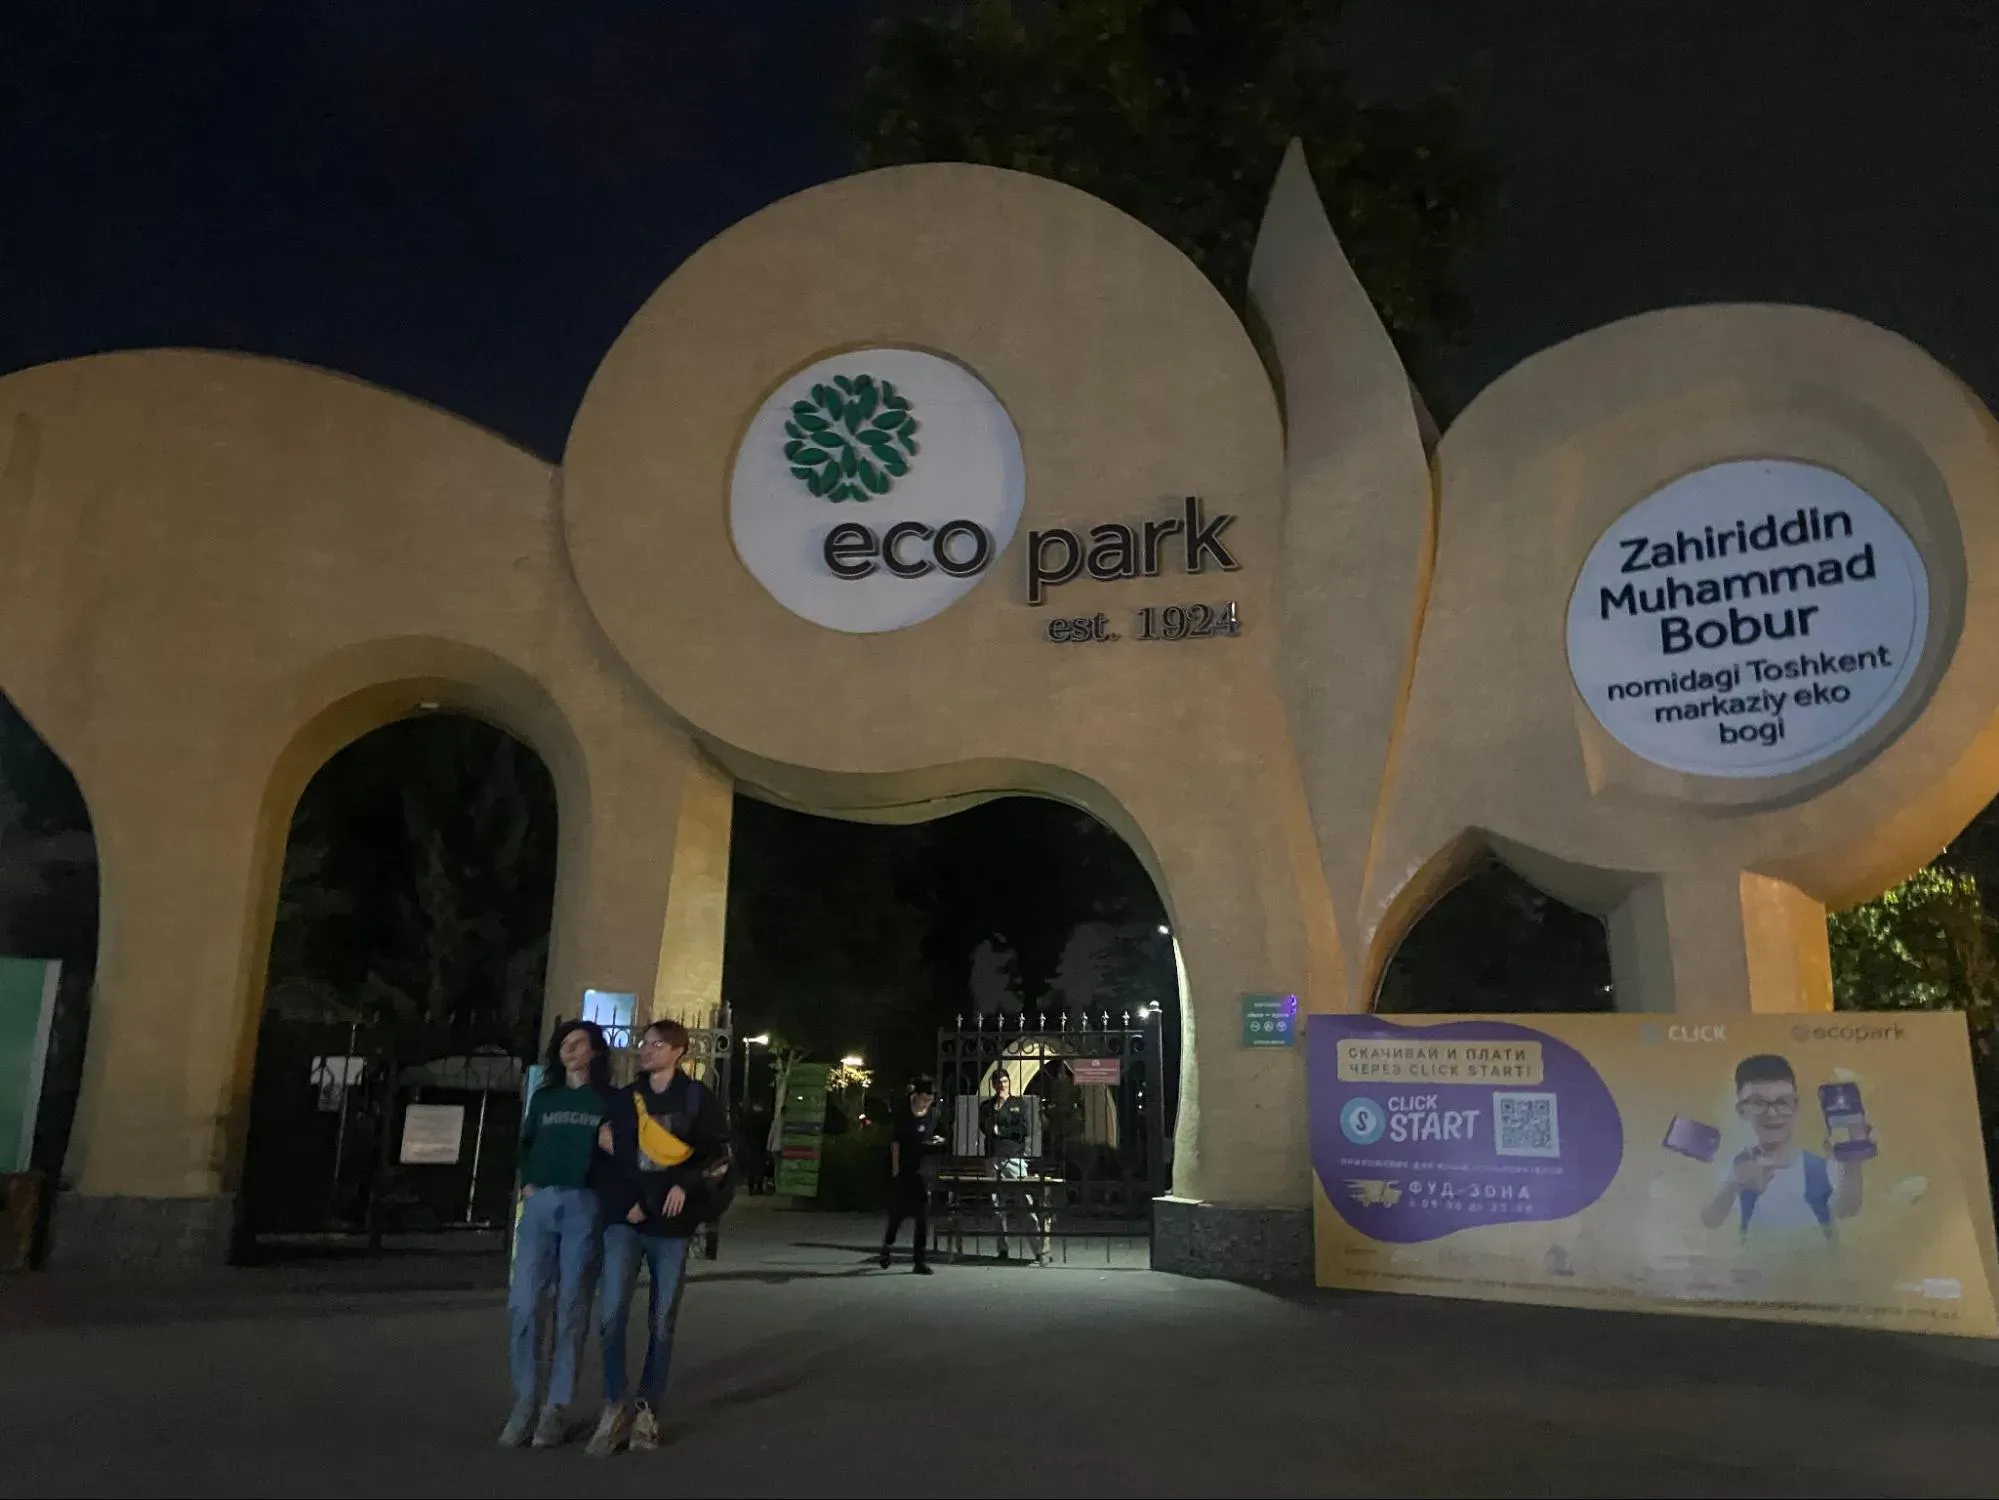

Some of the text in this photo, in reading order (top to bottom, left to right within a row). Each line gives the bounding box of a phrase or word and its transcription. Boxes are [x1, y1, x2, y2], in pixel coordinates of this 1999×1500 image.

[823, 496, 1240, 604] eco park
[1620, 507, 1853, 574] Zahiriddin
[1600, 543, 1876, 620] Muhammad
[1048, 601, 1241, 643] est. 1924
[1660, 605, 1819, 655] Bobur
[1607, 645, 1893, 701] nomidagi Toshkent
[1655, 682, 1851, 724] markaziy eko
[1719, 717, 1785, 747] bogi
[1447, 1048, 1457, 1060] И
[1466, 1047, 1526, 1061] ПЛАТИ
[1668, 1024, 1727, 1043] CLICK
[1349, 1063, 1401, 1076] ЧЕРЕЗ
[1409, 1064, 1459, 1077] CLICK
[1388, 1094, 1438, 1112] CLICK
[1390, 1110, 1480, 1142] START
